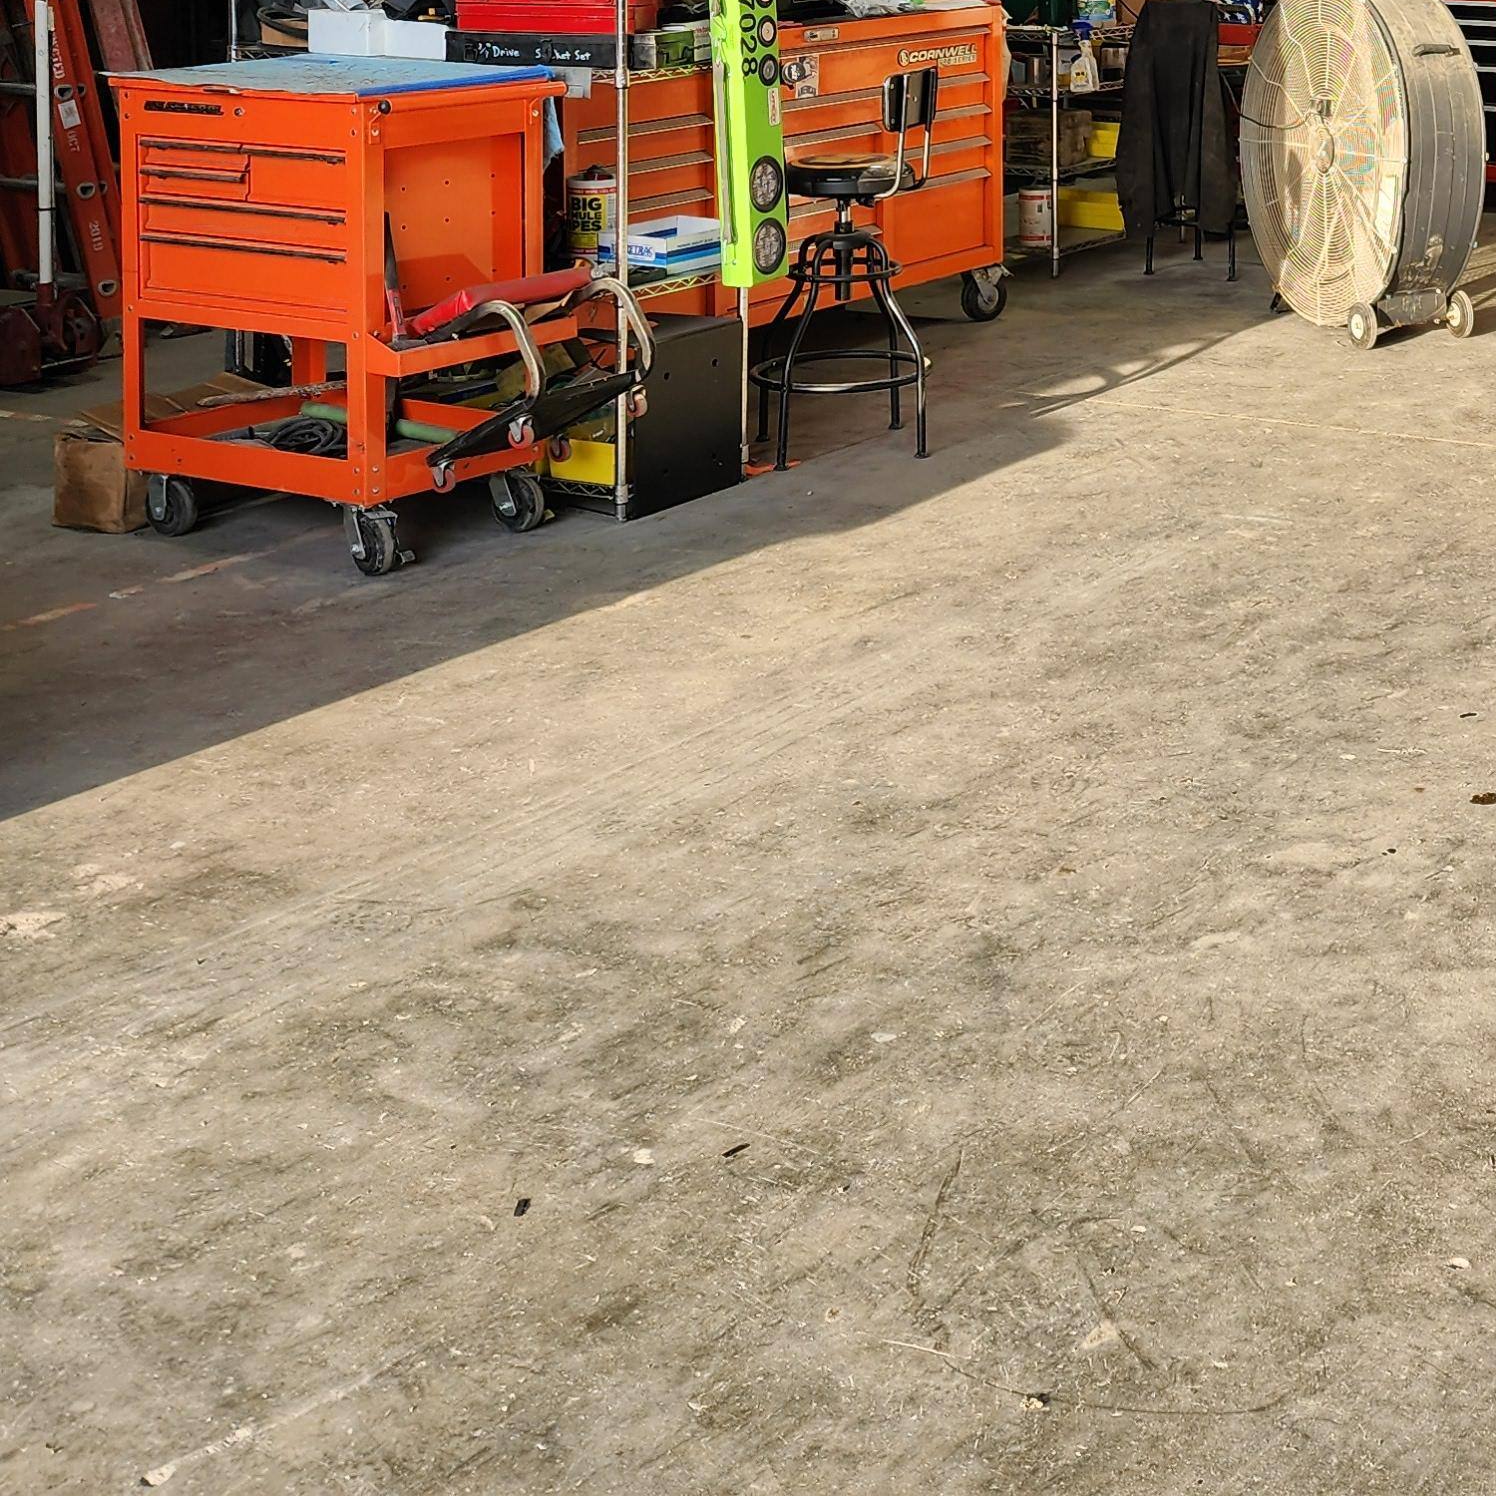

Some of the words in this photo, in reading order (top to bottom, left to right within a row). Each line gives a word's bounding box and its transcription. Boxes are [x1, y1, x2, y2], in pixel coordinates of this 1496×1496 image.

[493, 45, 520, 58] Drive
[574, 49, 591, 61] Set
[909, 44, 977, 63] CORNWELL
[571, 197, 602, 211] BIG
